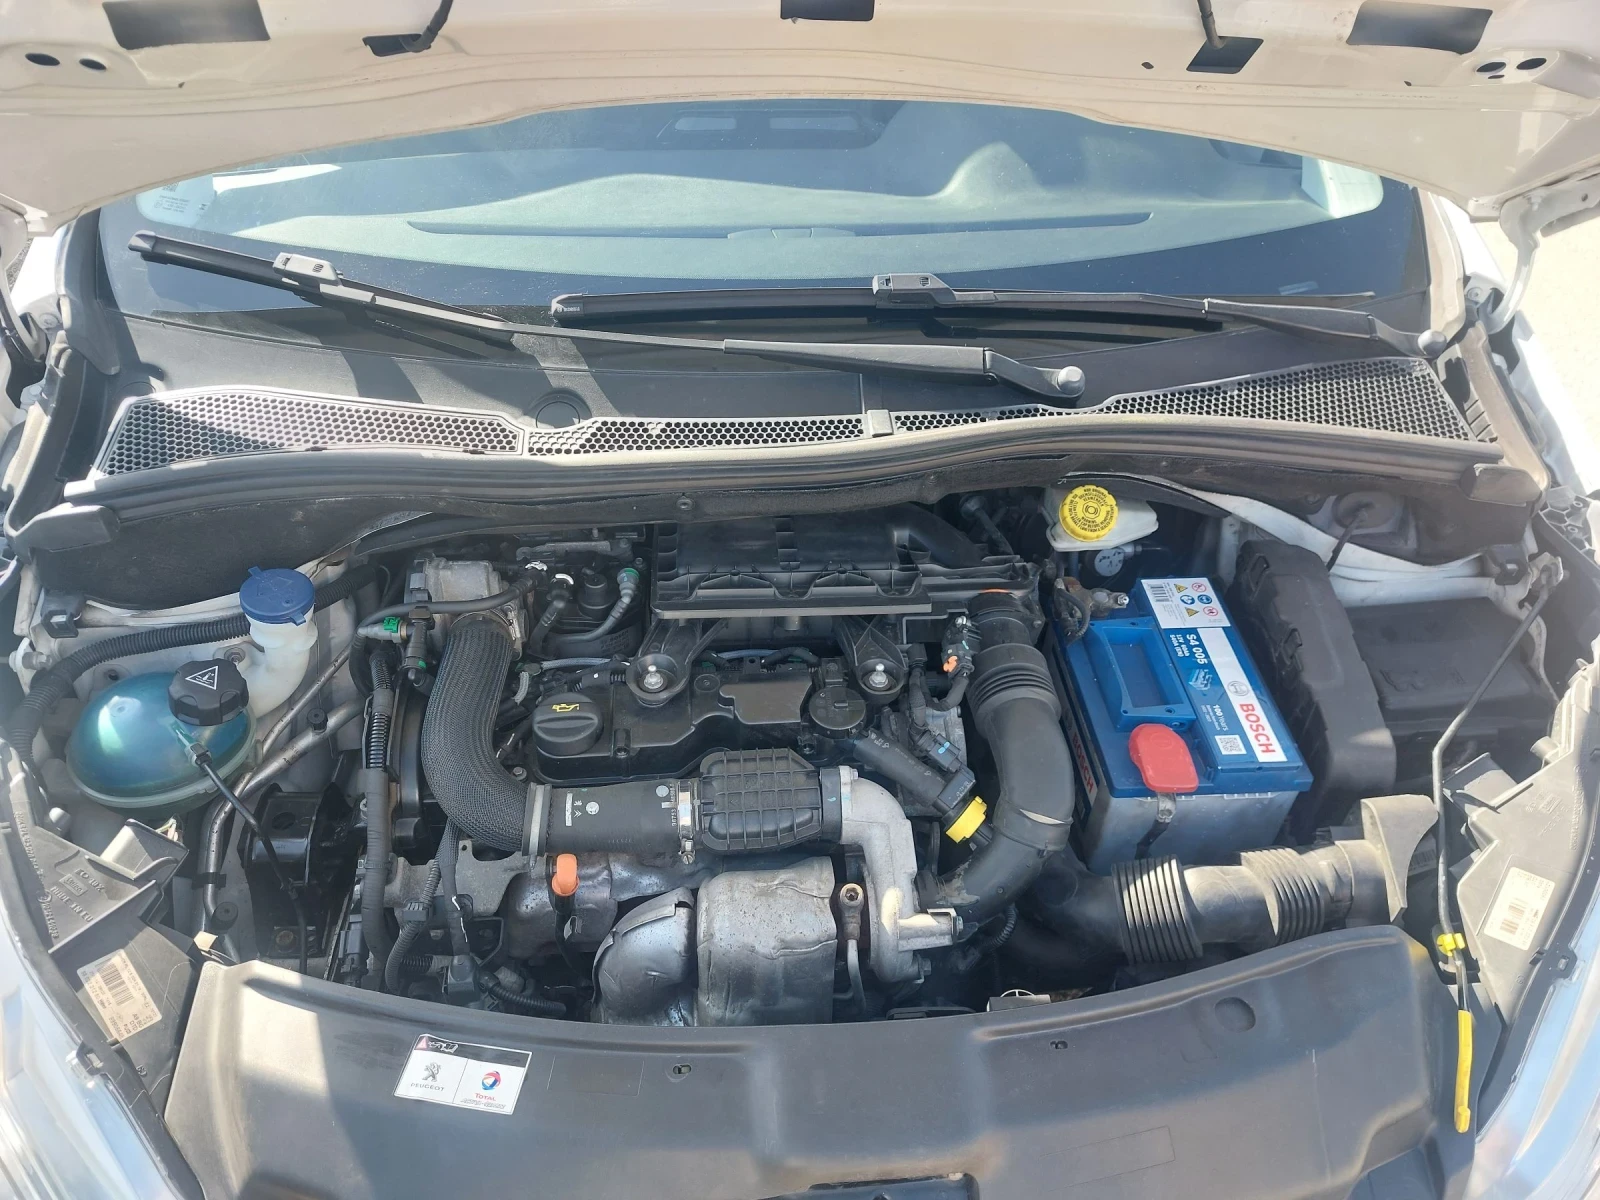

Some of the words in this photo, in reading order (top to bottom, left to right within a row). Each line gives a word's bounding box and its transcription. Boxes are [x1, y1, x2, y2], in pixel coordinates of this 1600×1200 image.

[1186, 634, 1200, 646] S4
[1192, 647, 1209, 665] 005
[1239, 703, 1276, 754] BOSCH
[1072, 731, 1094, 794] BOSCH
[70, 902, 83, 914] IN
[410, 1082, 445, 1092] PEUGEOT
[475, 1092, 497, 1102] TOTAL
